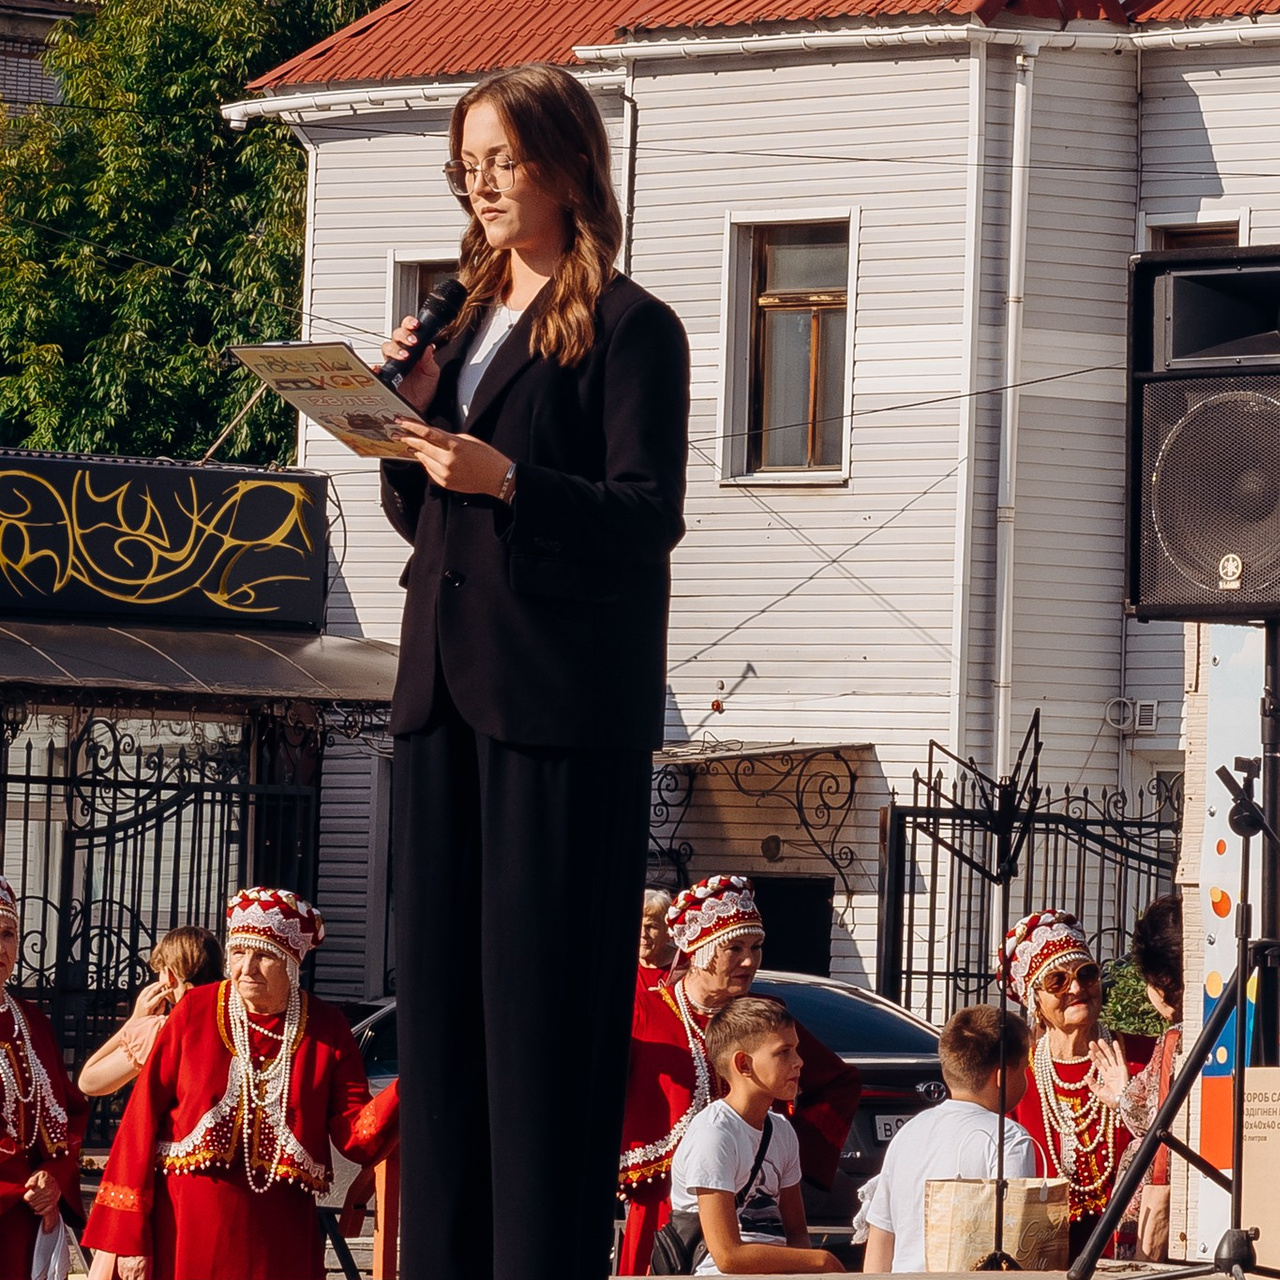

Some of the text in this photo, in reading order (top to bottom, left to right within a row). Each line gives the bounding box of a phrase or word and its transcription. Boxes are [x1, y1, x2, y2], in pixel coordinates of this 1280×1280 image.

[299, 395, 388, 407] 128 ЛЕТ
[1244, 1092, 1270, 1103] ОРОБ
[1244, 1107, 1278, 1118] ЗДІГІНЕН
